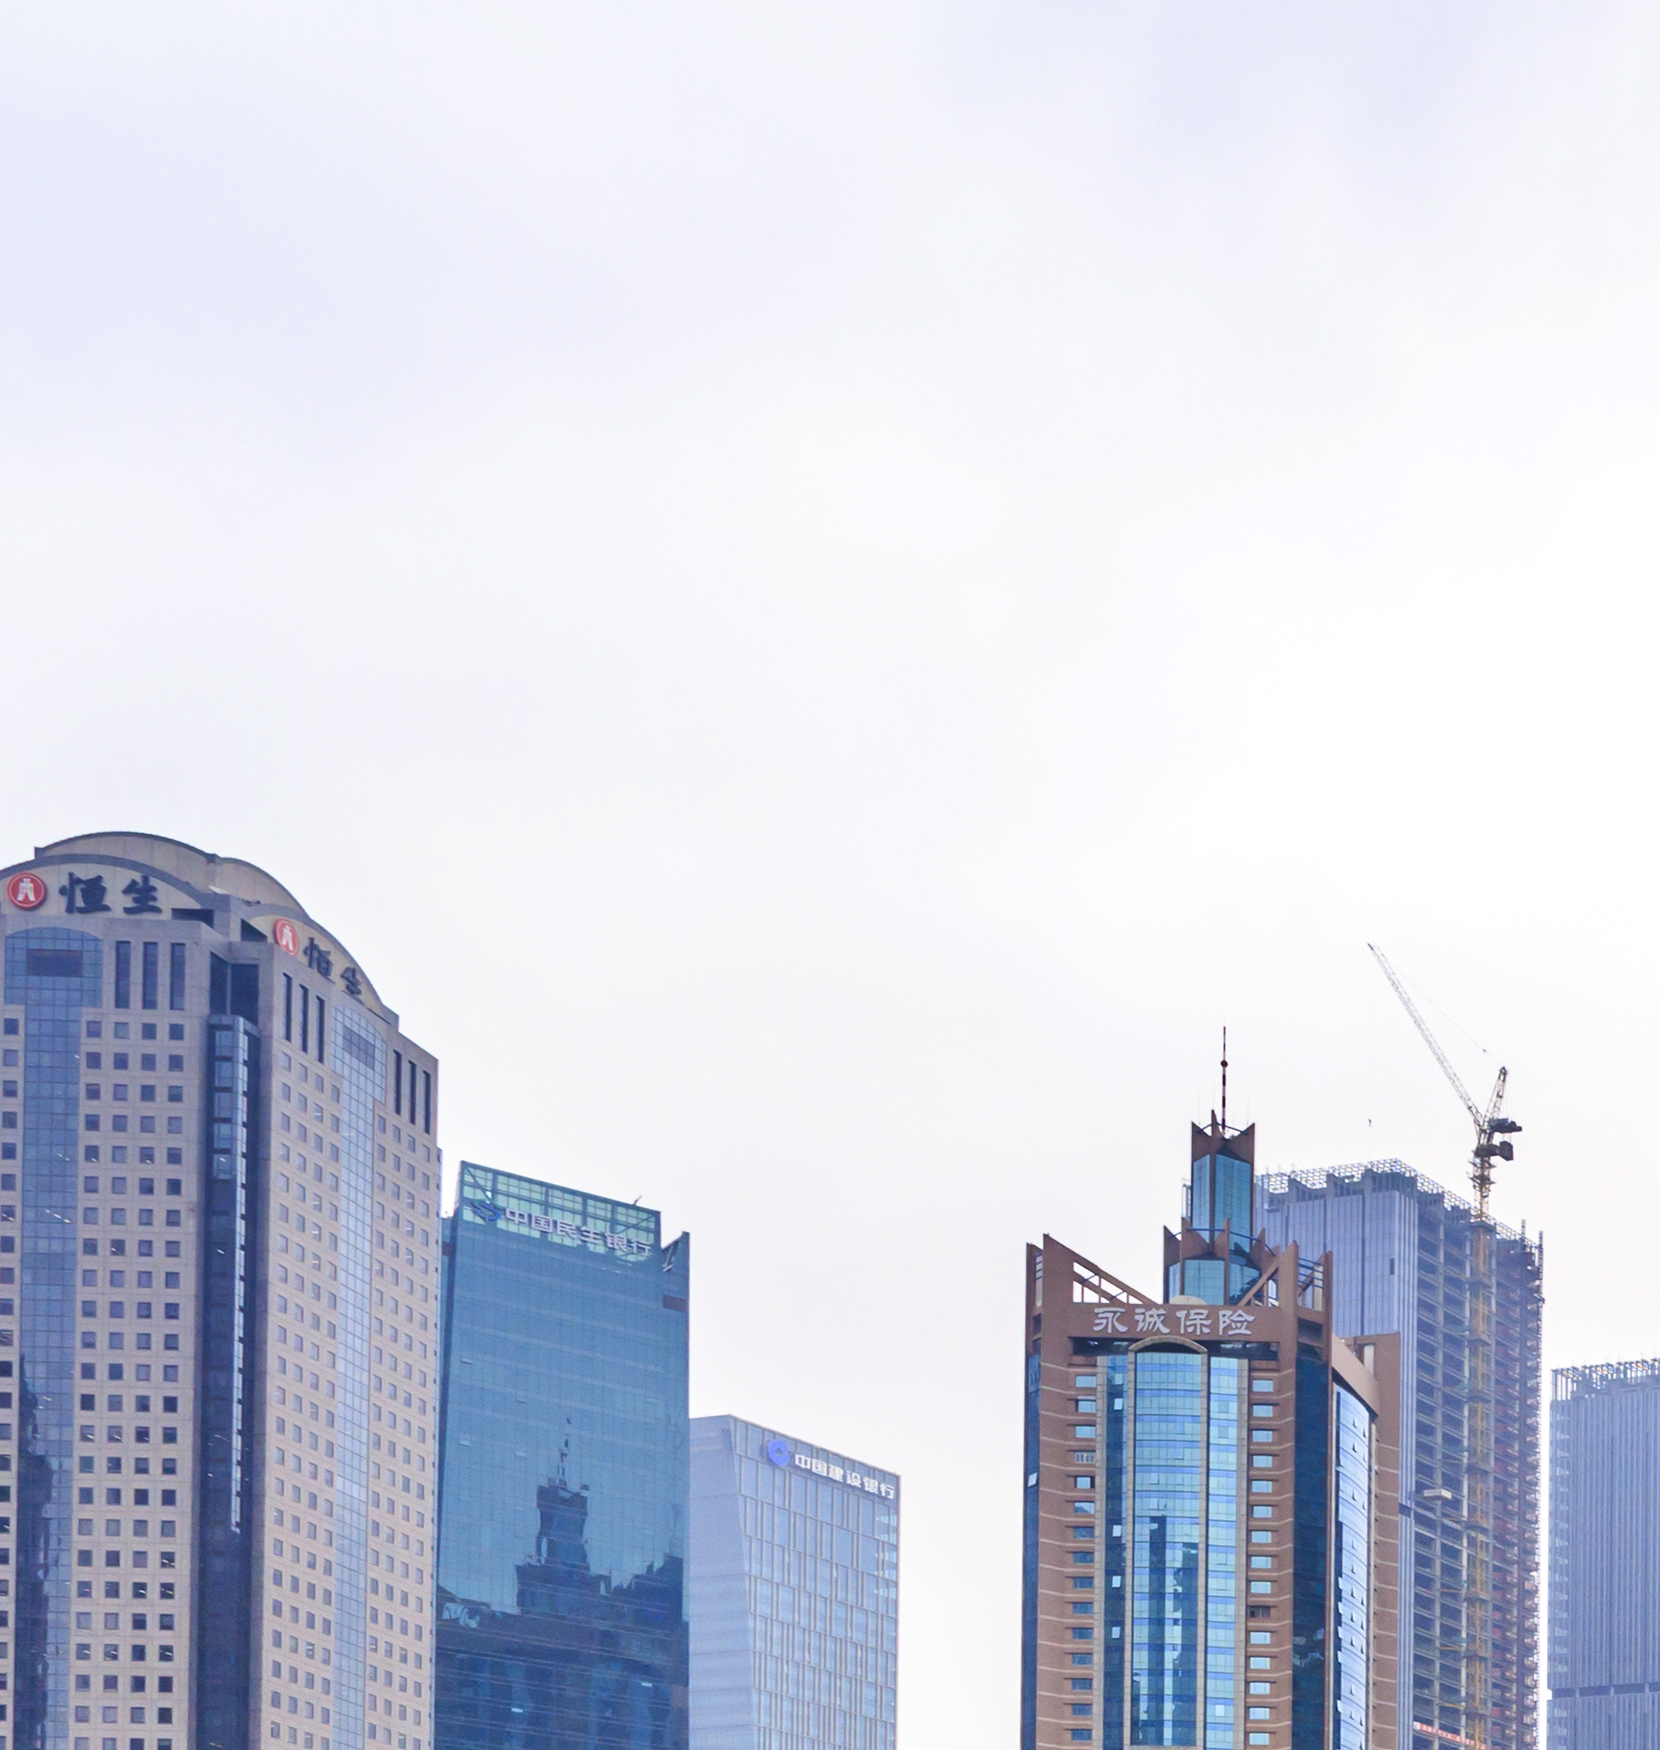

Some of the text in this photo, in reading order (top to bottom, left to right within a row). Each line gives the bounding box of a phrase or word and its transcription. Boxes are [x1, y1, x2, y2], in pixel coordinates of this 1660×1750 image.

[58, 871, 162, 914] 恒生
[303, 937, 363, 997] 恒生
[505, 1206, 653, 1256] 中国民生银行
[1092, 1307, 1255, 1336] 永诚保险
[794, 1453, 896, 1500] 中国建设银行
